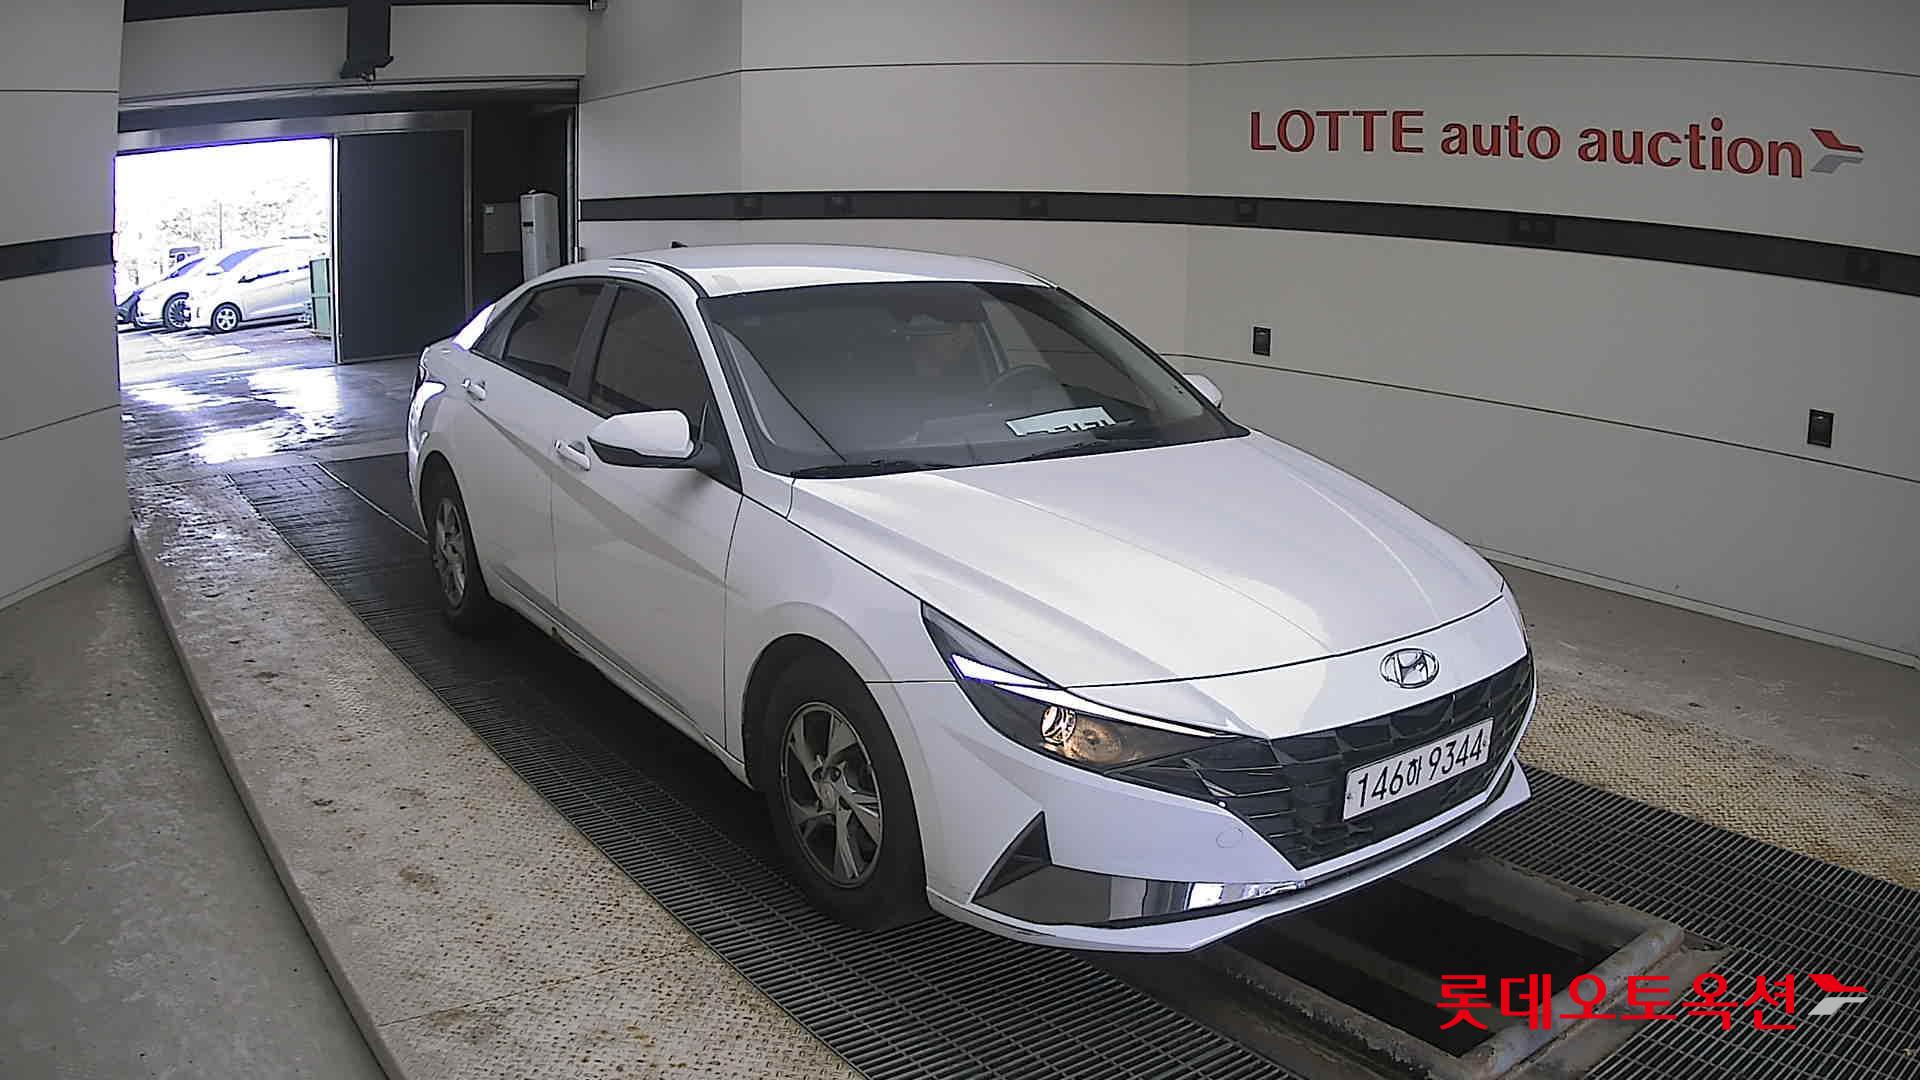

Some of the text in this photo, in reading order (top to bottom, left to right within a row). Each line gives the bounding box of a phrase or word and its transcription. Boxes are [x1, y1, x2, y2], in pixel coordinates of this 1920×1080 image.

[1249, 109, 1804, 179] LOTTE auto auction
[1358, 728, 1484, 807] 146하 9344
